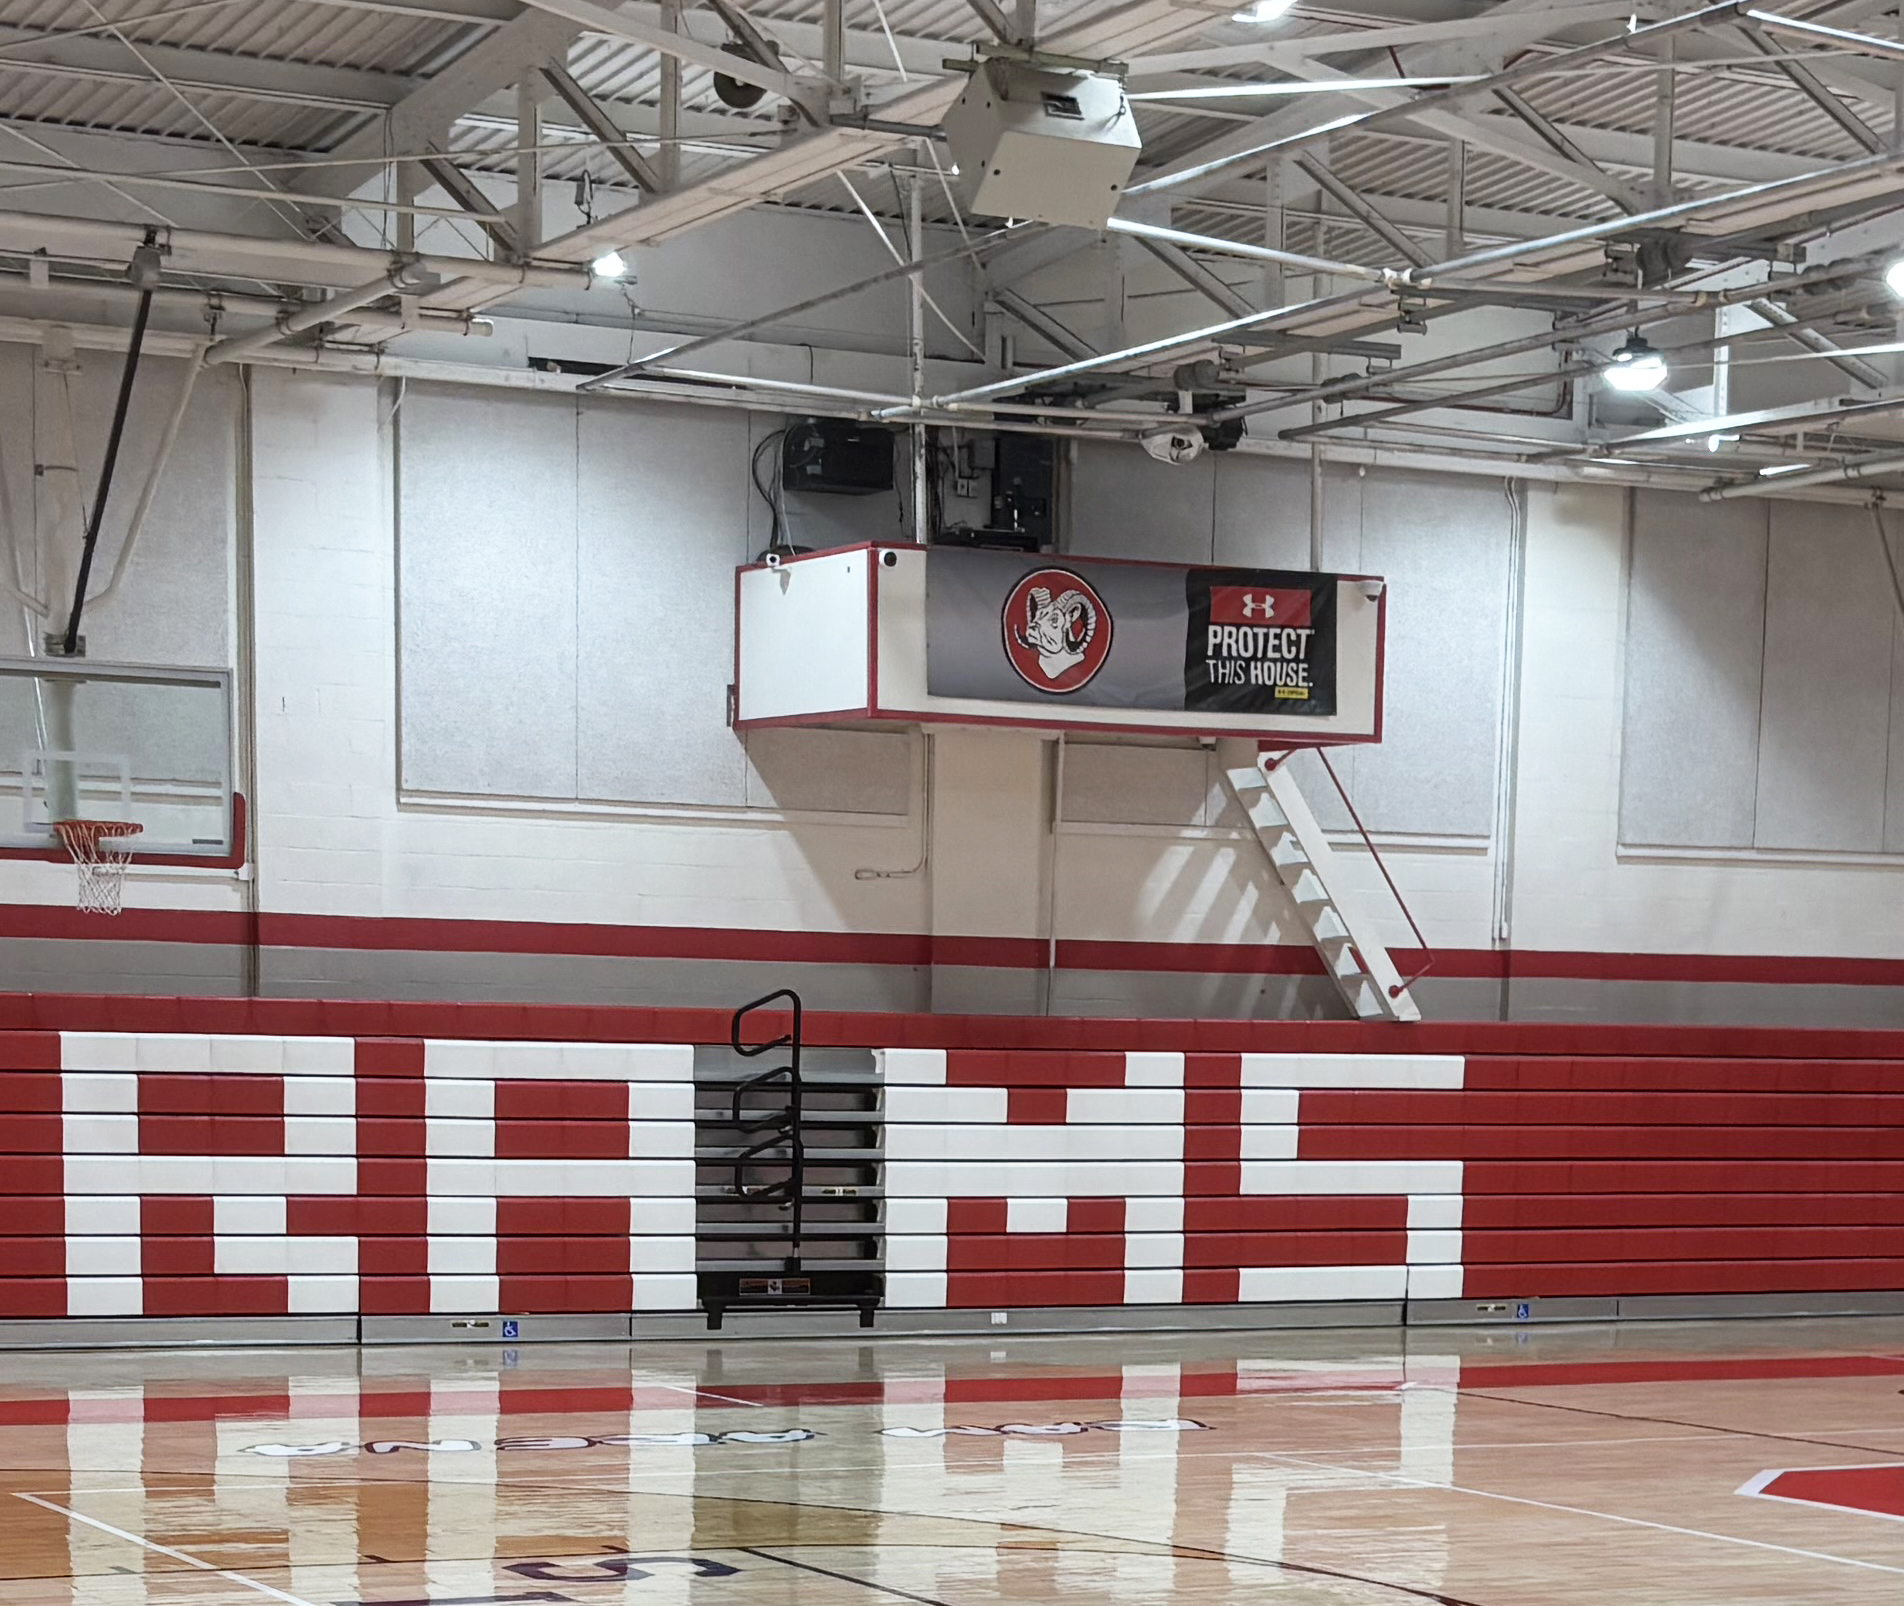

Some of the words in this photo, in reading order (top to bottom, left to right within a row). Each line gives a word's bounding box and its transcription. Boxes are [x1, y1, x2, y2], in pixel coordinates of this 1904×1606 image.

[1207, 624, 1313, 660] PROTECT
[1205, 659, 1246, 685] THIS
[1250, 661, 1314, 687] HOUSE.
[60, 1031, 1464, 1318] RAMS
